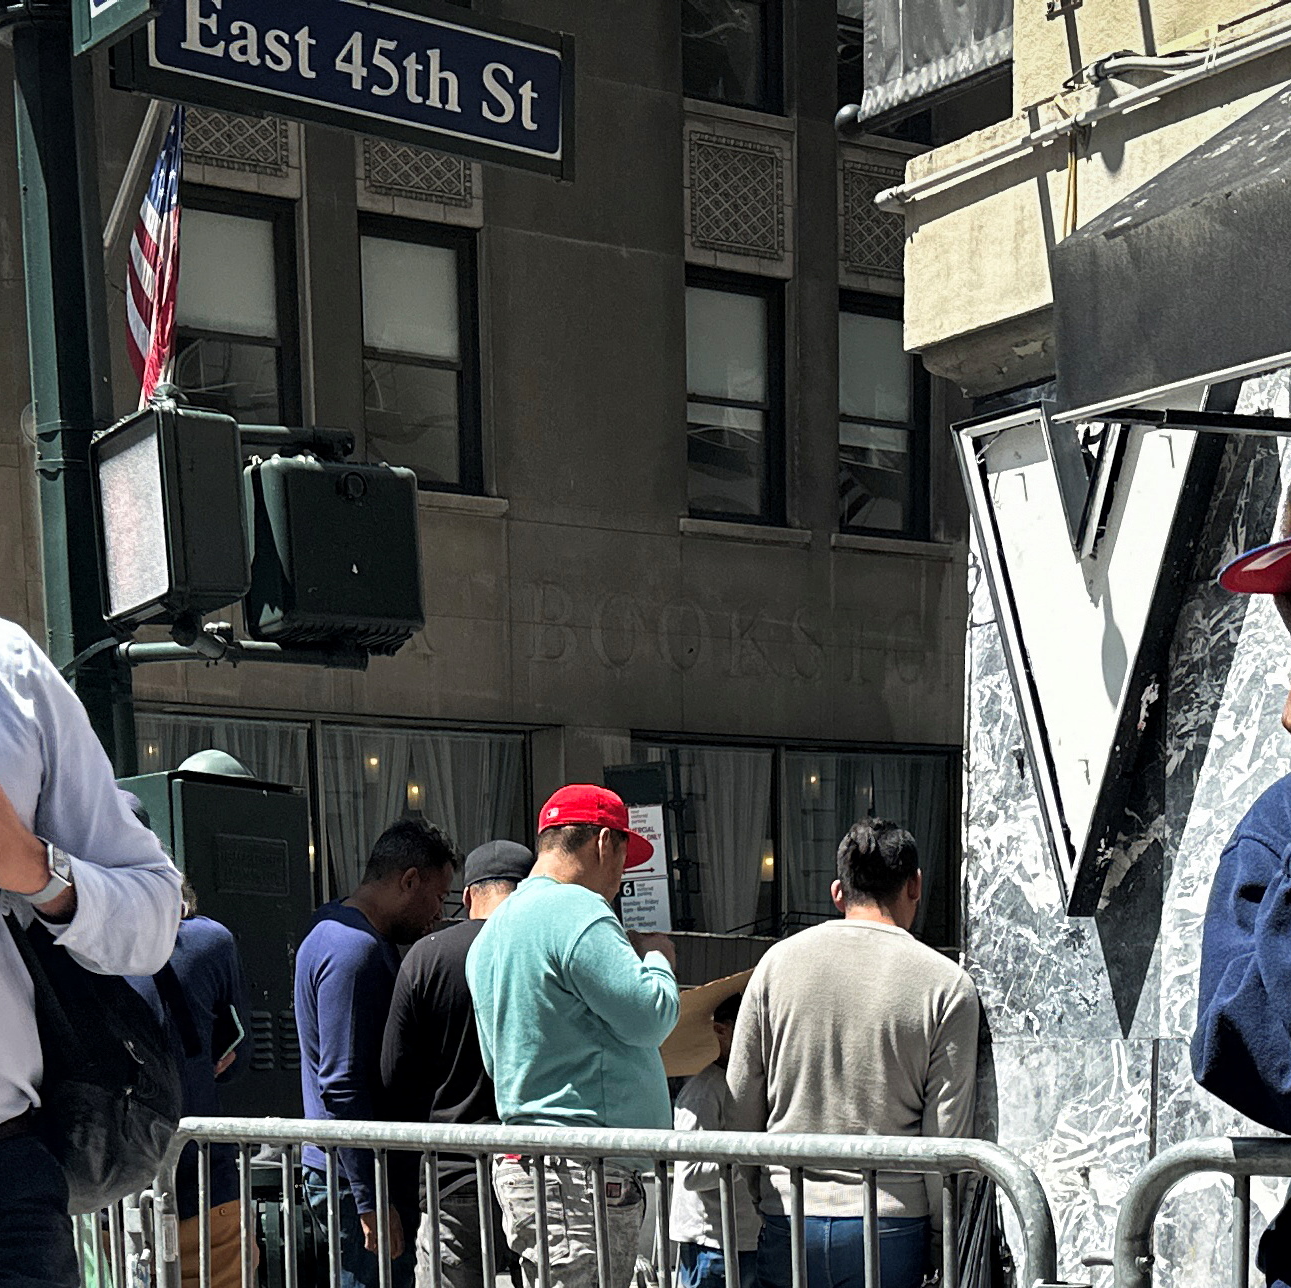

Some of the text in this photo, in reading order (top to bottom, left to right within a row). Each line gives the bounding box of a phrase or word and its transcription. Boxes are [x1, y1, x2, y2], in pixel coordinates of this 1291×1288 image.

[180, 0, 539, 131] East 45th St
[623, 882, 632, 896] 6
